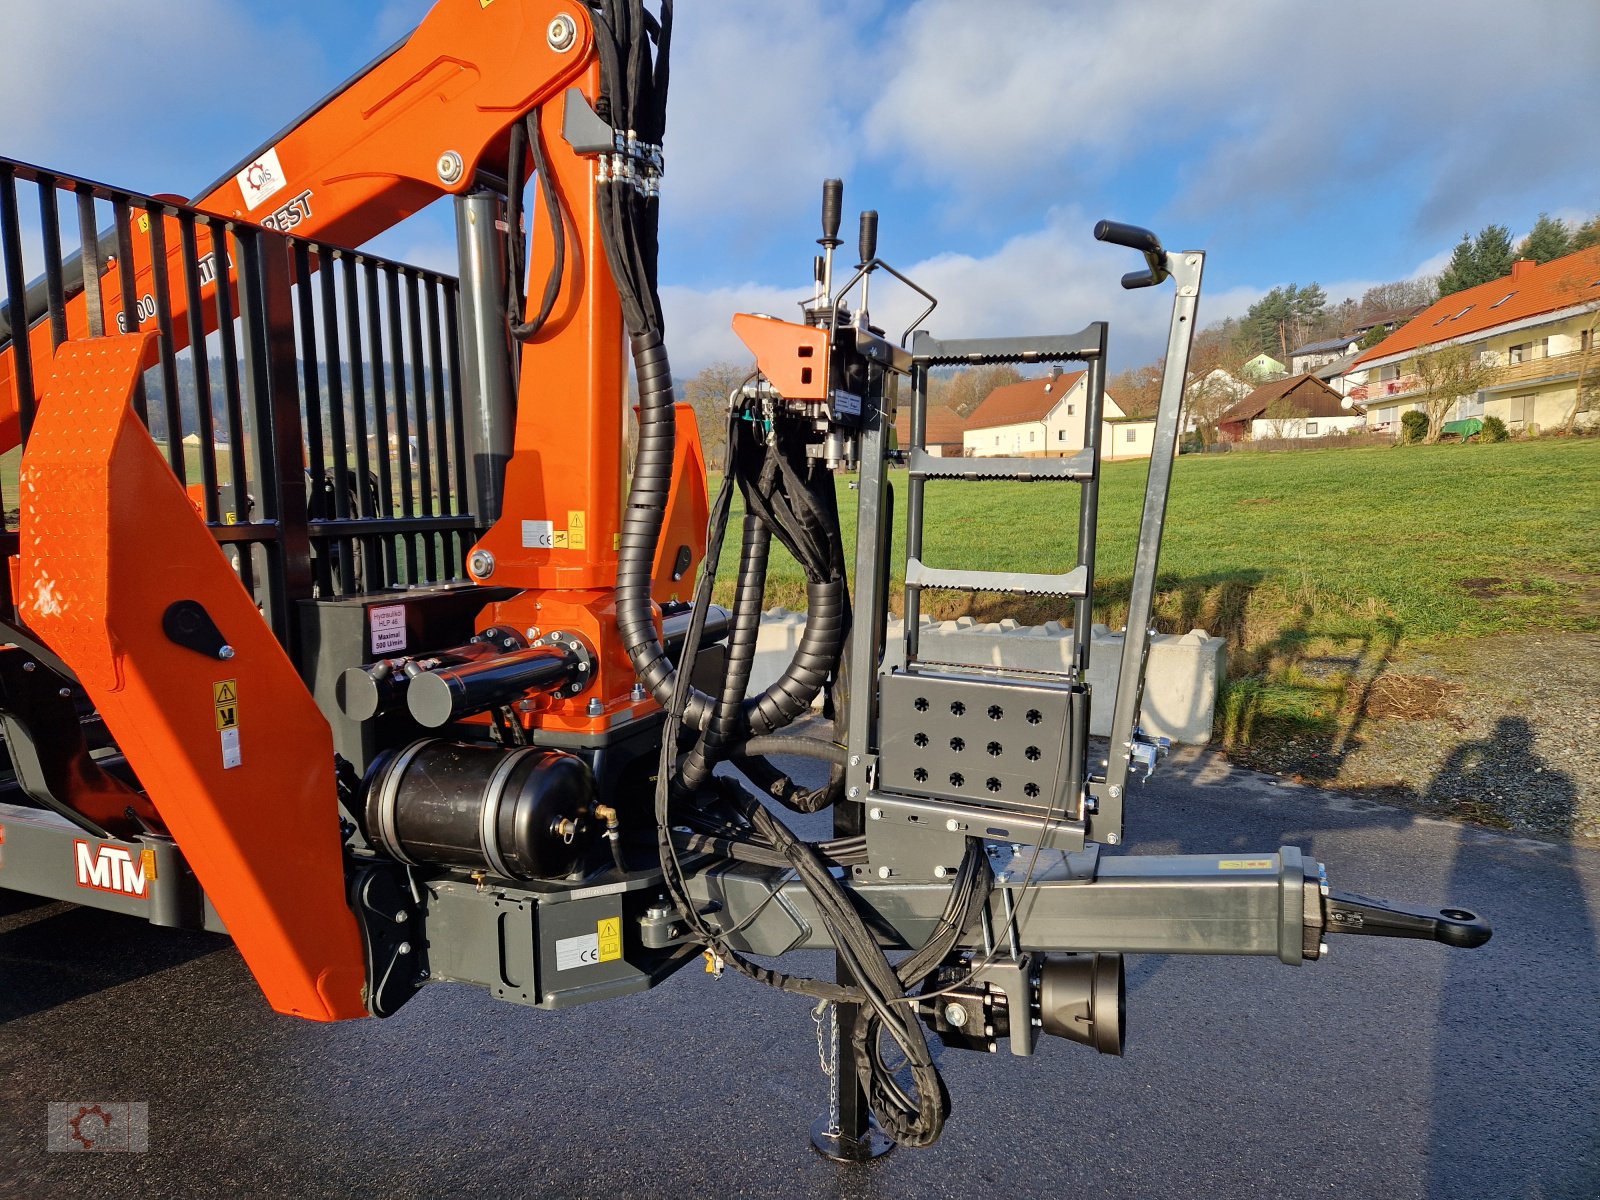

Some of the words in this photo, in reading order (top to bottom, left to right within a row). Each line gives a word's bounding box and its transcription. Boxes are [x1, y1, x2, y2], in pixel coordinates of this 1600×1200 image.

[116, 293, 156, 335] 800
[539, 534, 551, 546] CE
[379, 619, 390, 627] HLP
[378, 632, 400, 640] Maximal
[376, 641, 386, 649] 500
[387, 639, 403, 647] U/min
[75, 841, 147, 895] MTM
[580, 948, 598, 963] CE
